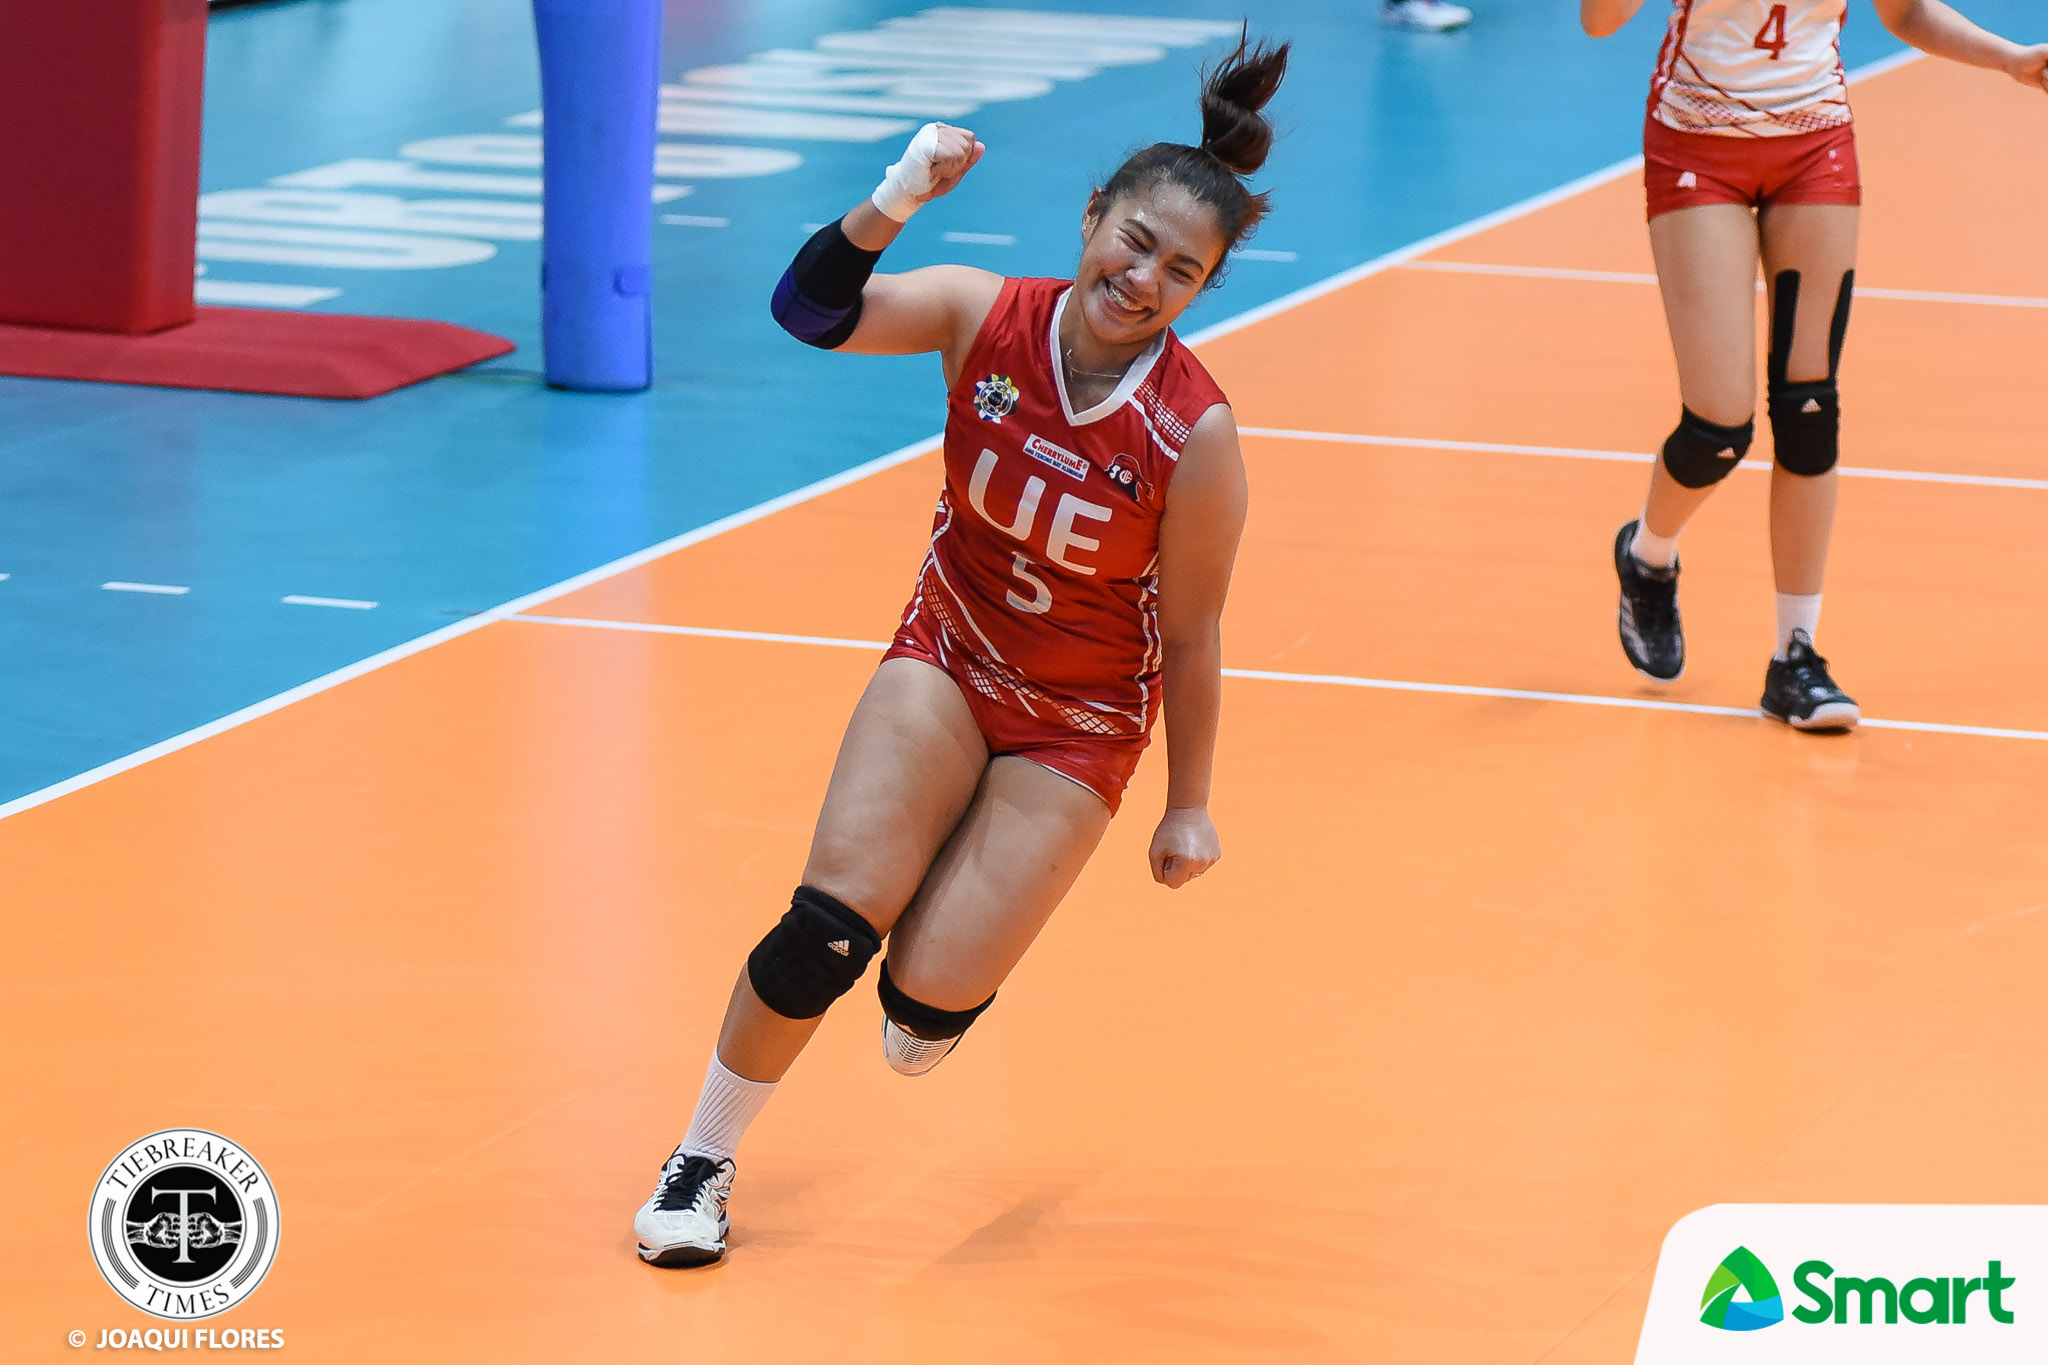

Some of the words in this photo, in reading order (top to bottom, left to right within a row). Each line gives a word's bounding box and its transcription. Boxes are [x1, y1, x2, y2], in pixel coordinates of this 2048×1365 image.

[1754, 4, 1788, 61] 4
[968, 448, 1113, 576] UE
[1006, 551, 1053, 615] 5
